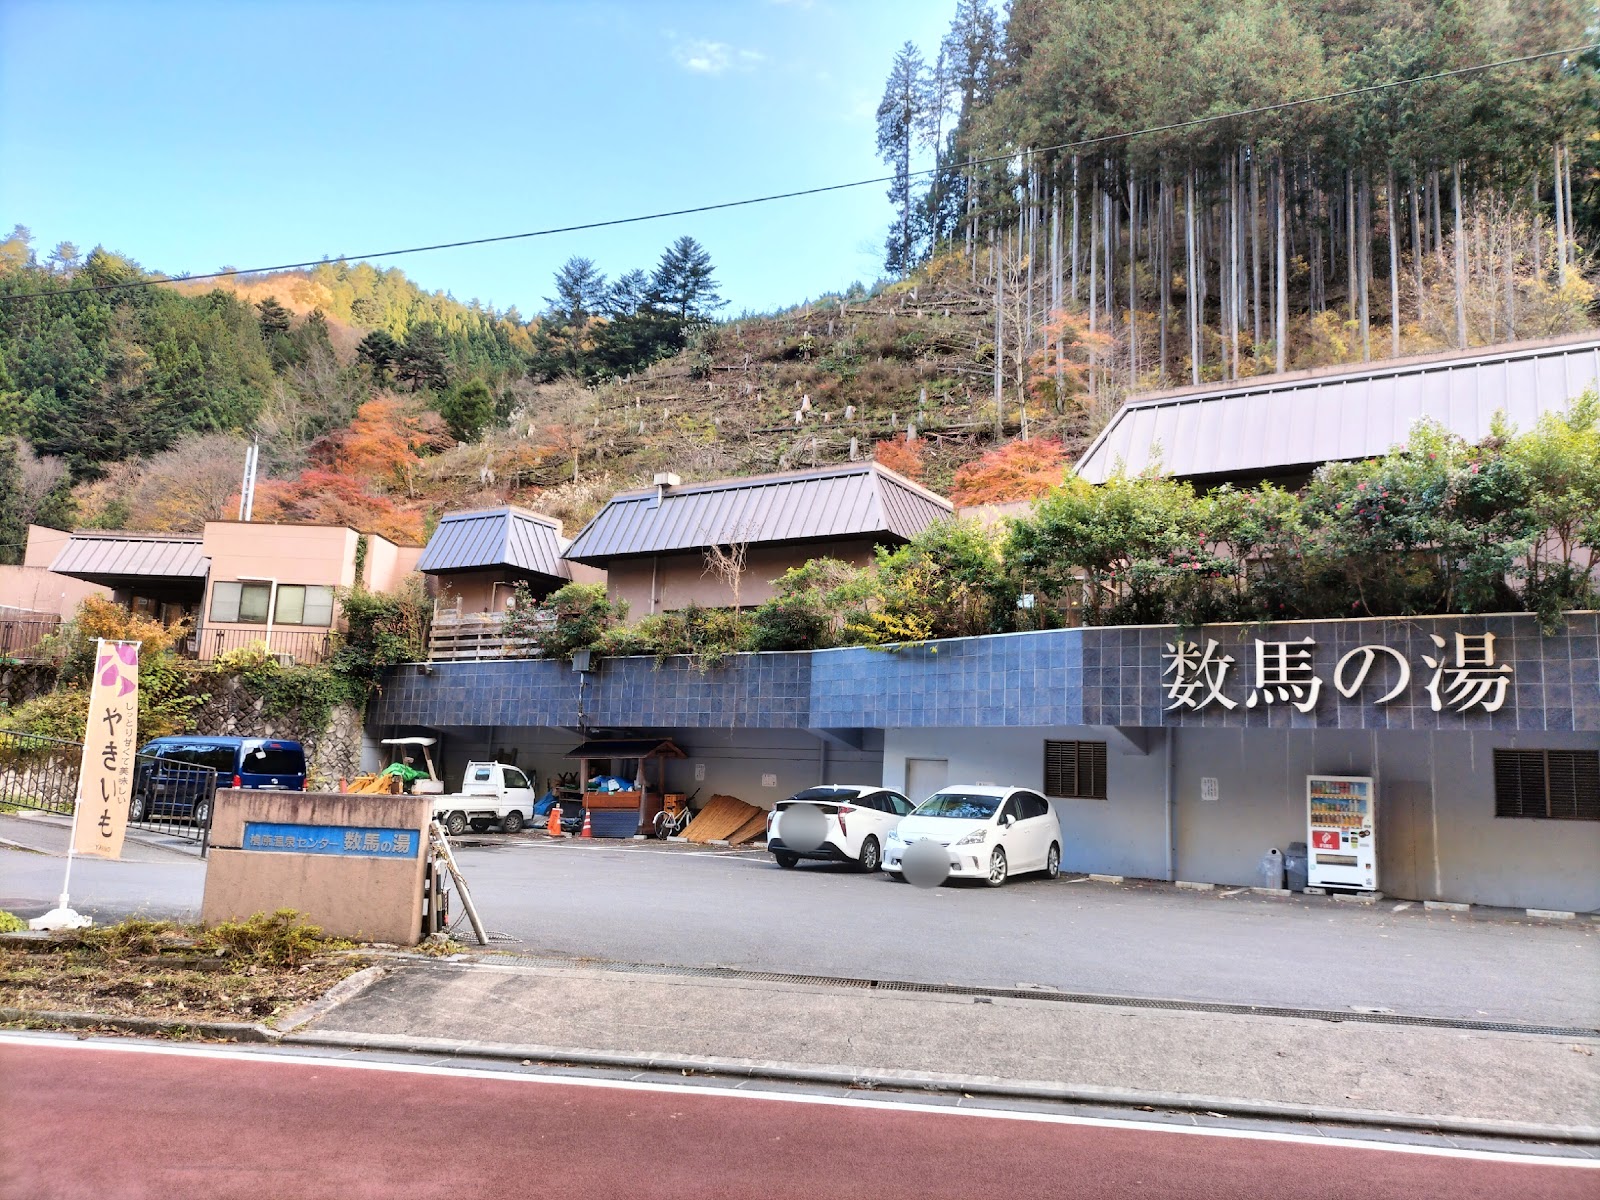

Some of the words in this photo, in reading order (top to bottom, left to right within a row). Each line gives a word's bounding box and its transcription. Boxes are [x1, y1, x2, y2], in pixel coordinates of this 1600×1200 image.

[1161, 632, 1513, 713] 数馬の湯
[98, 707, 123, 838] やきいも
[117, 702, 134, 805] しっとり甘くて美味しい
[343, 831, 411, 854] 数馬の湯
